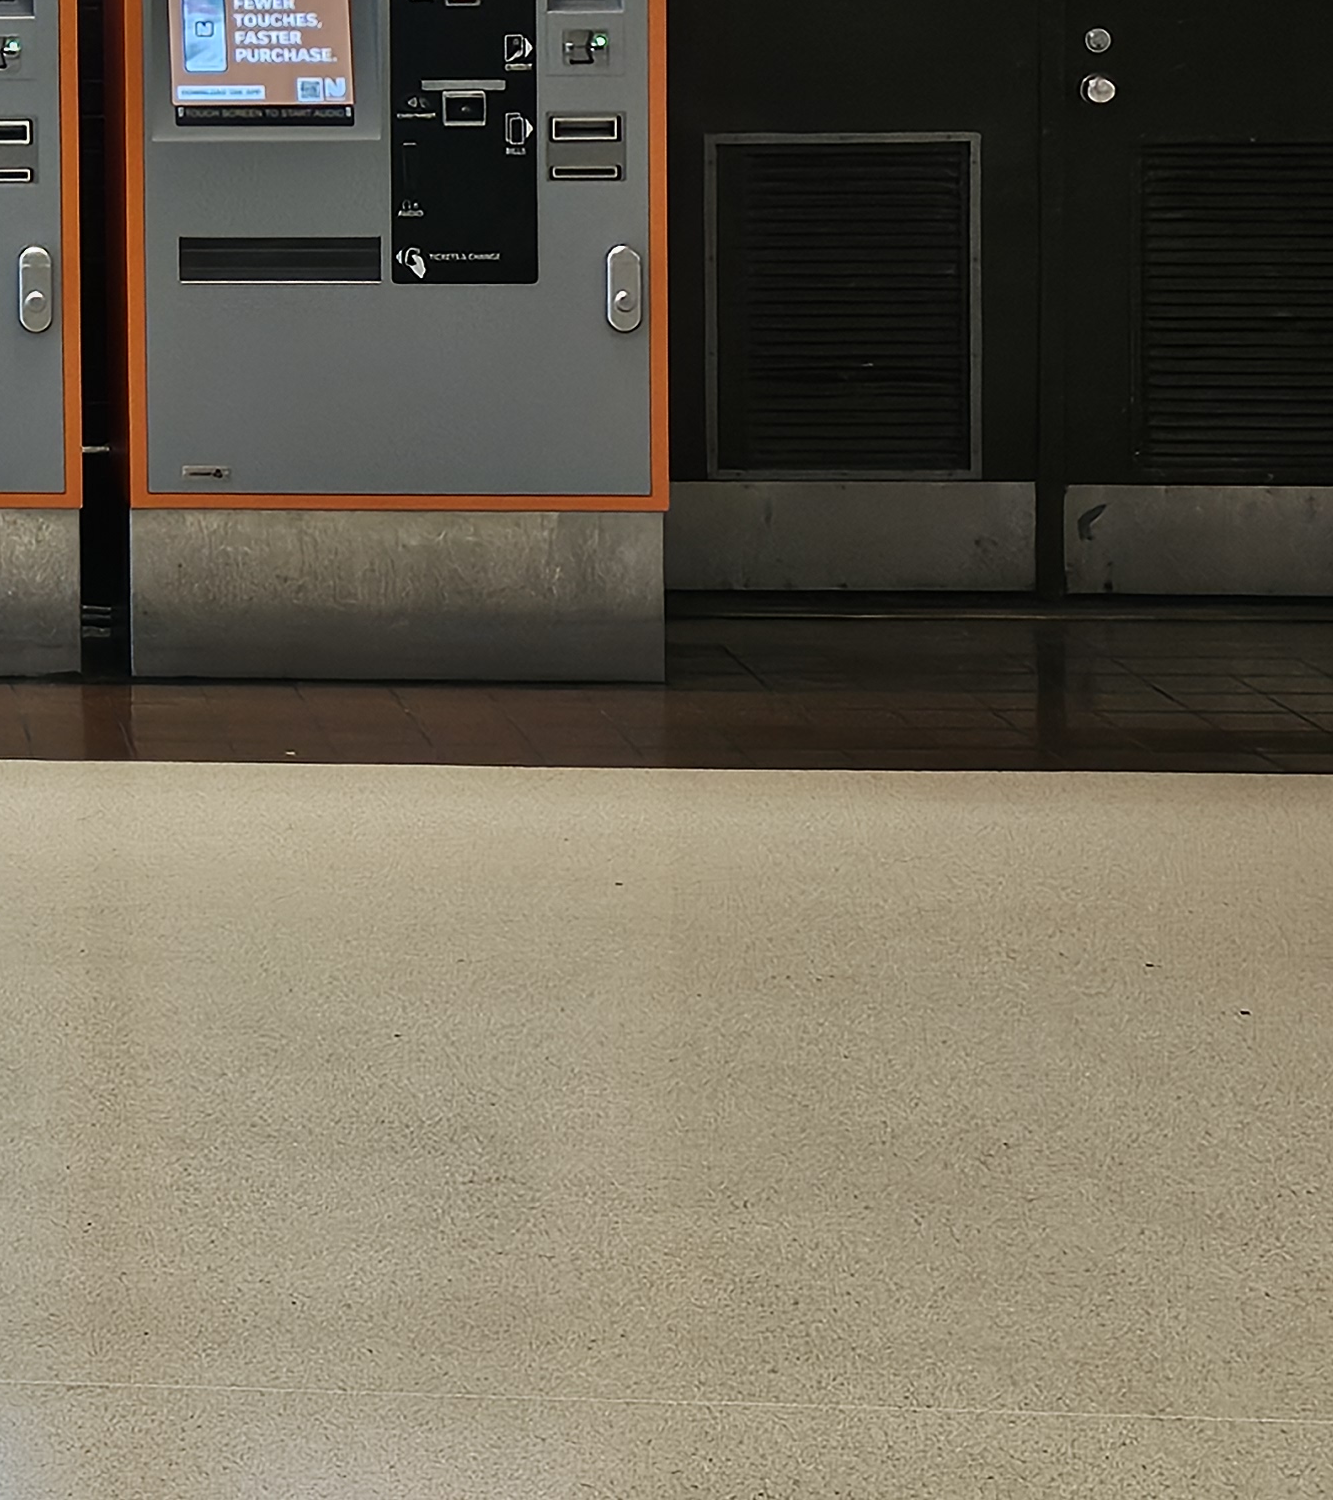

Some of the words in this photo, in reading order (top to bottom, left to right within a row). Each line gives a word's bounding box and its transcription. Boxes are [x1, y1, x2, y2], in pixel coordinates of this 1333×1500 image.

[233, 13, 322, 28] TOUCHES,
[234, 30, 302, 45] FASTER
[235, 48, 337, 63] PURCHASE.
